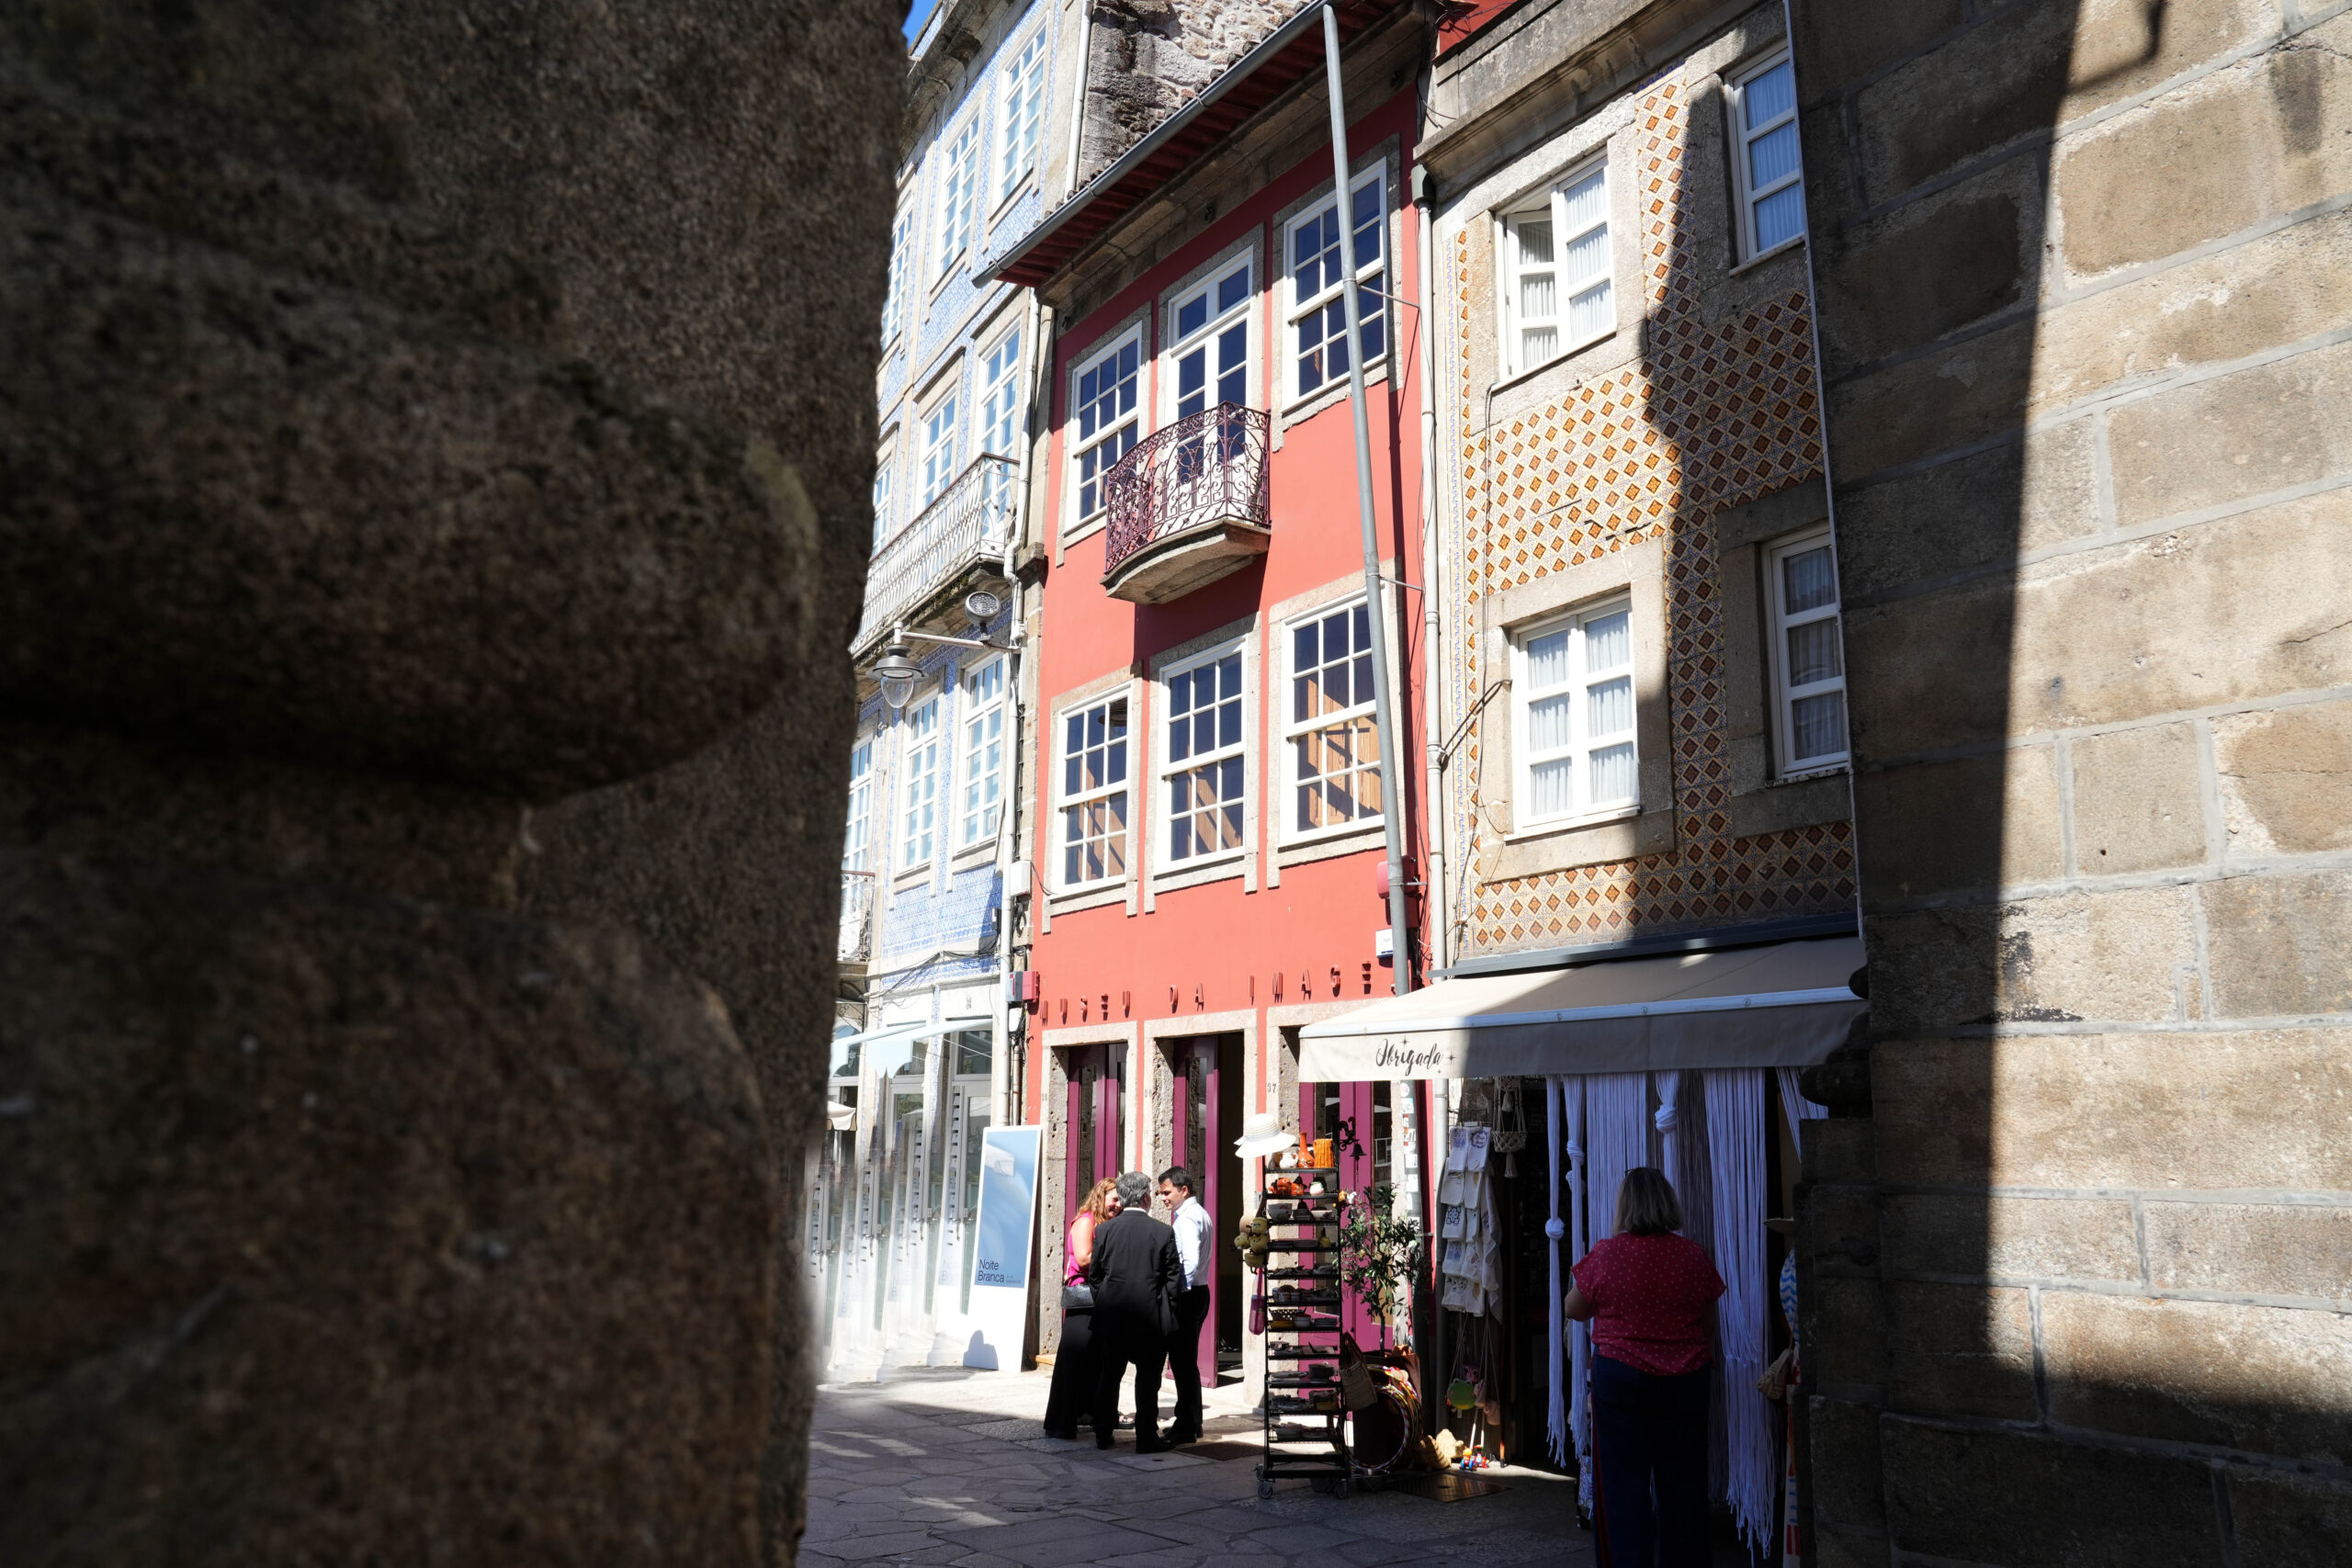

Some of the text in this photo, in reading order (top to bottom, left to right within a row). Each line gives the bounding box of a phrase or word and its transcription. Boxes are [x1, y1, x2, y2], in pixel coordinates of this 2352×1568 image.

[1040, 961, 1372, 1022] MUSEU DA IMAGE
[1375, 1038, 1442, 1077] Obrigada
[978, 1258, 1000, 1270] Noite
[978, 1270, 1005, 1283] Branca
